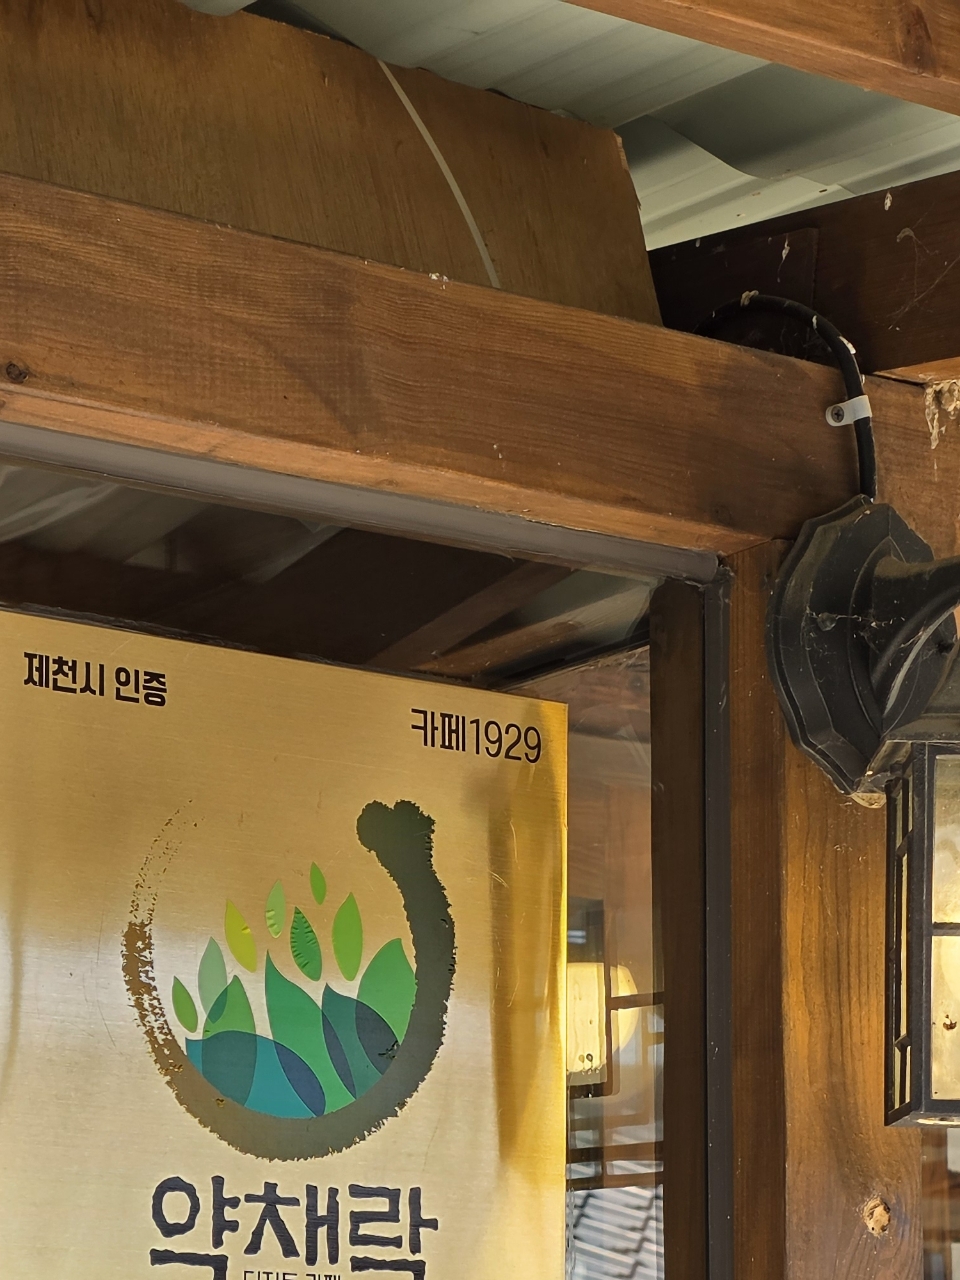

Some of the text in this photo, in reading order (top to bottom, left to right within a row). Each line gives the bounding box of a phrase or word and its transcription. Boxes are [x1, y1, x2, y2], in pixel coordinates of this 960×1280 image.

[23, 651, 168, 708] 제천시 인증
[410, 707, 542, 764] 카페1929
